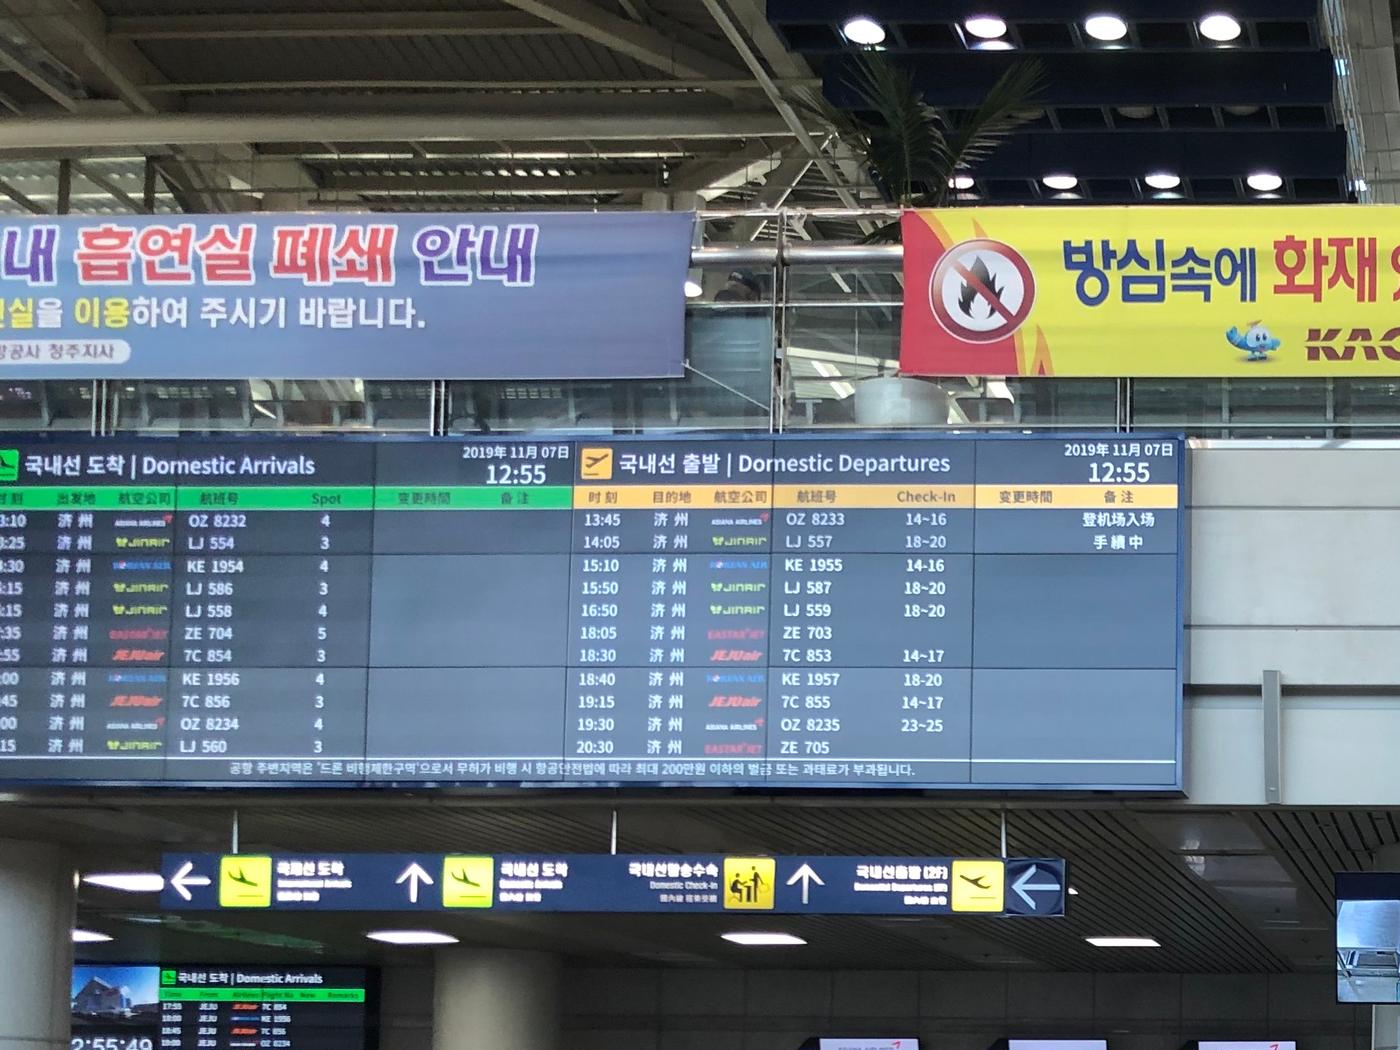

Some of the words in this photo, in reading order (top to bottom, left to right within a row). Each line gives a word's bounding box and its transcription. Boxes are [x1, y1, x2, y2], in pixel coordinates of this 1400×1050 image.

[75, 224, 257, 286] 흡연실
[270, 224, 399, 286] 폐쇄
[413, 224, 539, 286] 안내
[1063, 237, 1257, 307] 방심속에
[1273, 234, 1377, 303] 화재
[74, 298, 188, 328] 이용하여
[200, 298, 286, 328] 주시기
[301, 298, 426, 329] 바랍니다.
[463, 446, 506, 459] 2019年
[511, 446, 538, 460] 11月
[542, 446, 569, 460] 07日
[1064, 443, 1109, 457] 2019年
[1113, 443, 1140, 457] 11月
[1145, 443, 1173, 457] 07日
[25, 455, 81, 476] 국내선
[87, 455, 125, 476] 도착
[142, 456, 234, 475] Domestic
[240, 456, 315, 475] Arrivals
[619, 454, 675, 474] 국내선
[682, 454, 720, 474] 출발
[739, 454, 833, 474] Domestic
[838, 454, 950, 477] Departures
[1088, 462, 1150, 483] 12:55
[486, 464, 546, 485] 12:55
[312, 493, 341, 507] Spot
[897, 490, 956, 503] Check-In
[189, 513, 208, 528] OZ
[214, 513, 246, 528] 8232
[585, 513, 620, 527] 13:45
[786, 512, 805, 526] OZ
[812, 512, 844, 526] 8233
[584, 536, 619, 550] 14:05
[583, 558, 619, 574] 15:10
[785, 558, 803, 572] KE
[810, 558, 842, 572] 1955
[582, 603, 617, 617] 16:50
[784, 603, 799, 617] LJ
[806, 603, 831, 617] 559
[185, 626, 202, 640] ZE
[208, 626, 232, 640] 704
[581, 626, 616, 640] 18:05
[580, 648, 616, 662] 18:30
[579, 695, 614, 709] 19:15
[181, 718, 200, 732] OZ
[206, 718, 239, 732] 8234
[578, 718, 614, 732] 19:30
[781, 718, 800, 732] OZ
[807, 718, 840, 732] 8235
[662, 763, 705, 776] 200만원
[710, 763, 744, 776] 이하의
[776, 763, 799, 776] 또는
[178, 973, 207, 984] 국내선
[236, 973, 284, 984] Domestic
[285, 974, 323, 984] Arrivals
